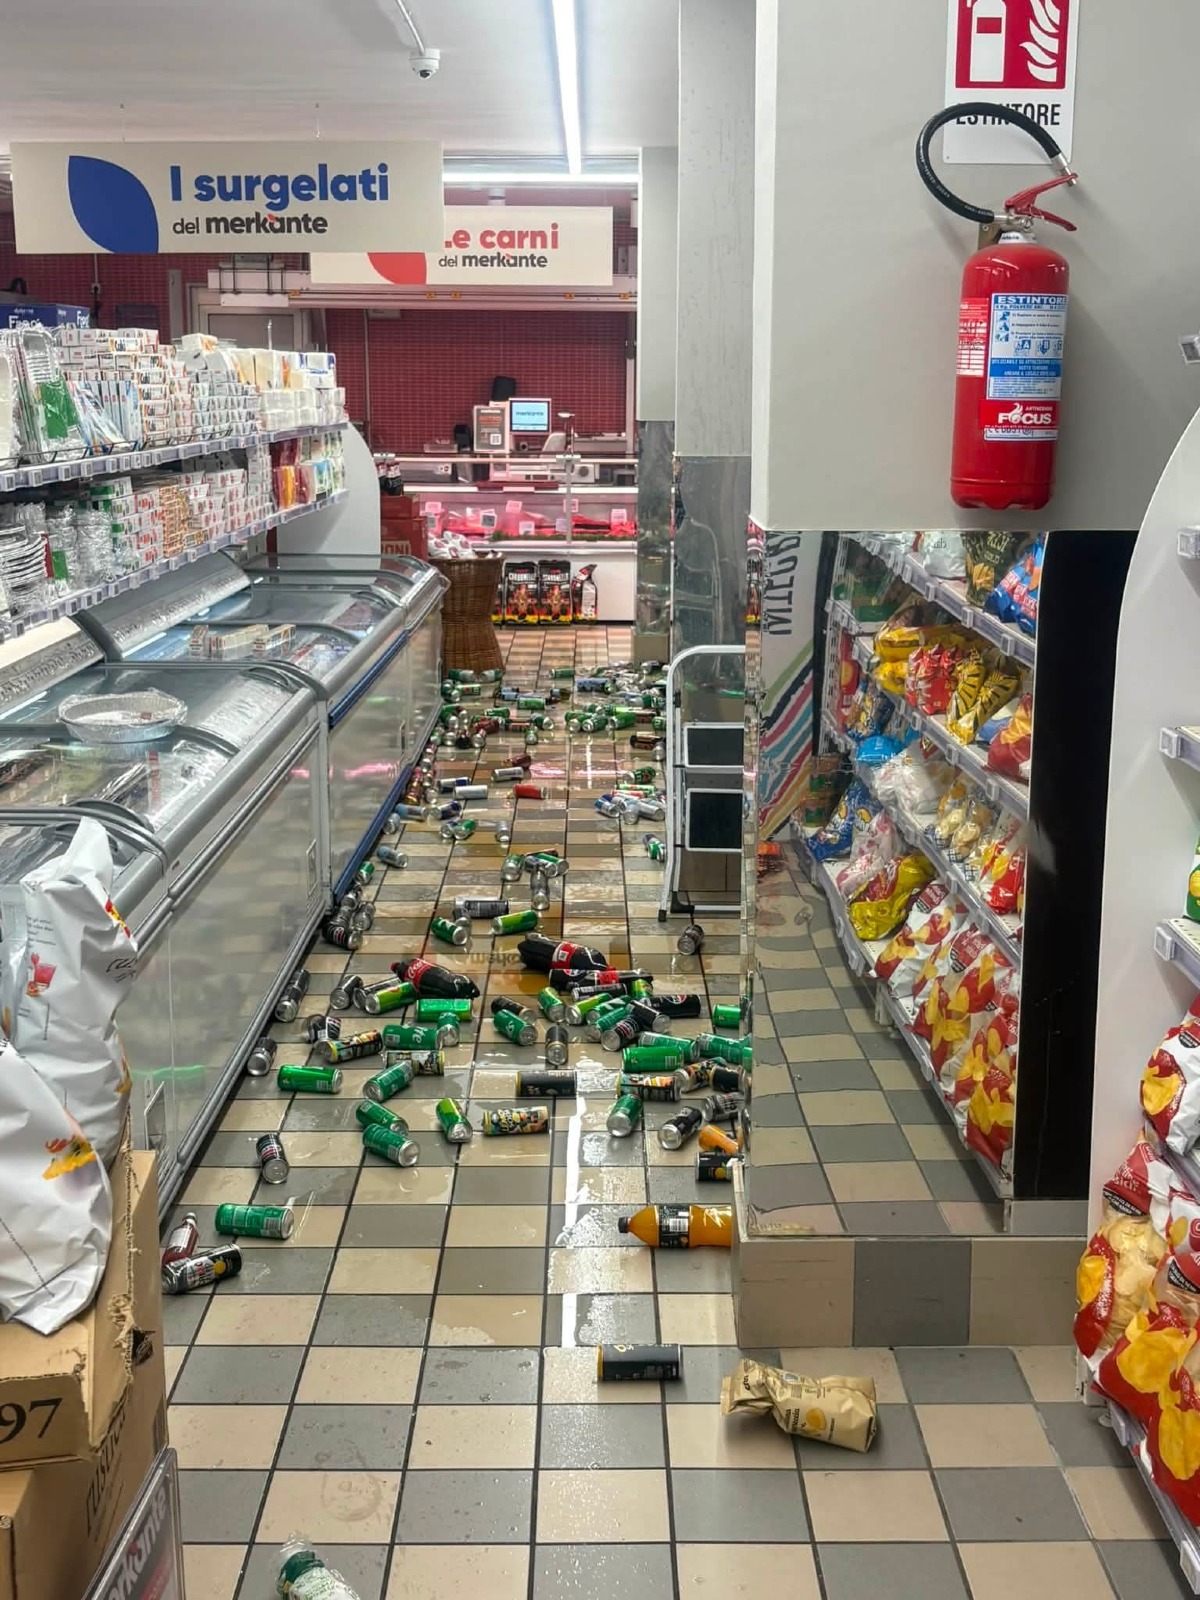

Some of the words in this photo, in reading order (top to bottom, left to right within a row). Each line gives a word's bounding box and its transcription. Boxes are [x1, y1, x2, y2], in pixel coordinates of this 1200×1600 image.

[170, 165, 181, 201] I
[194, 163, 389, 211] surgelati
[172, 216, 200, 235] del
[206, 211, 328, 235] merkante
[444, 228, 471, 249] e
[480, 223, 559, 250] carni
[439, 253, 458, 268] del
[462, 252, 548, 269] merkante
[998, 296, 1066, 305] ESTINTORE
[998, 409, 1052, 425] FOCUS
